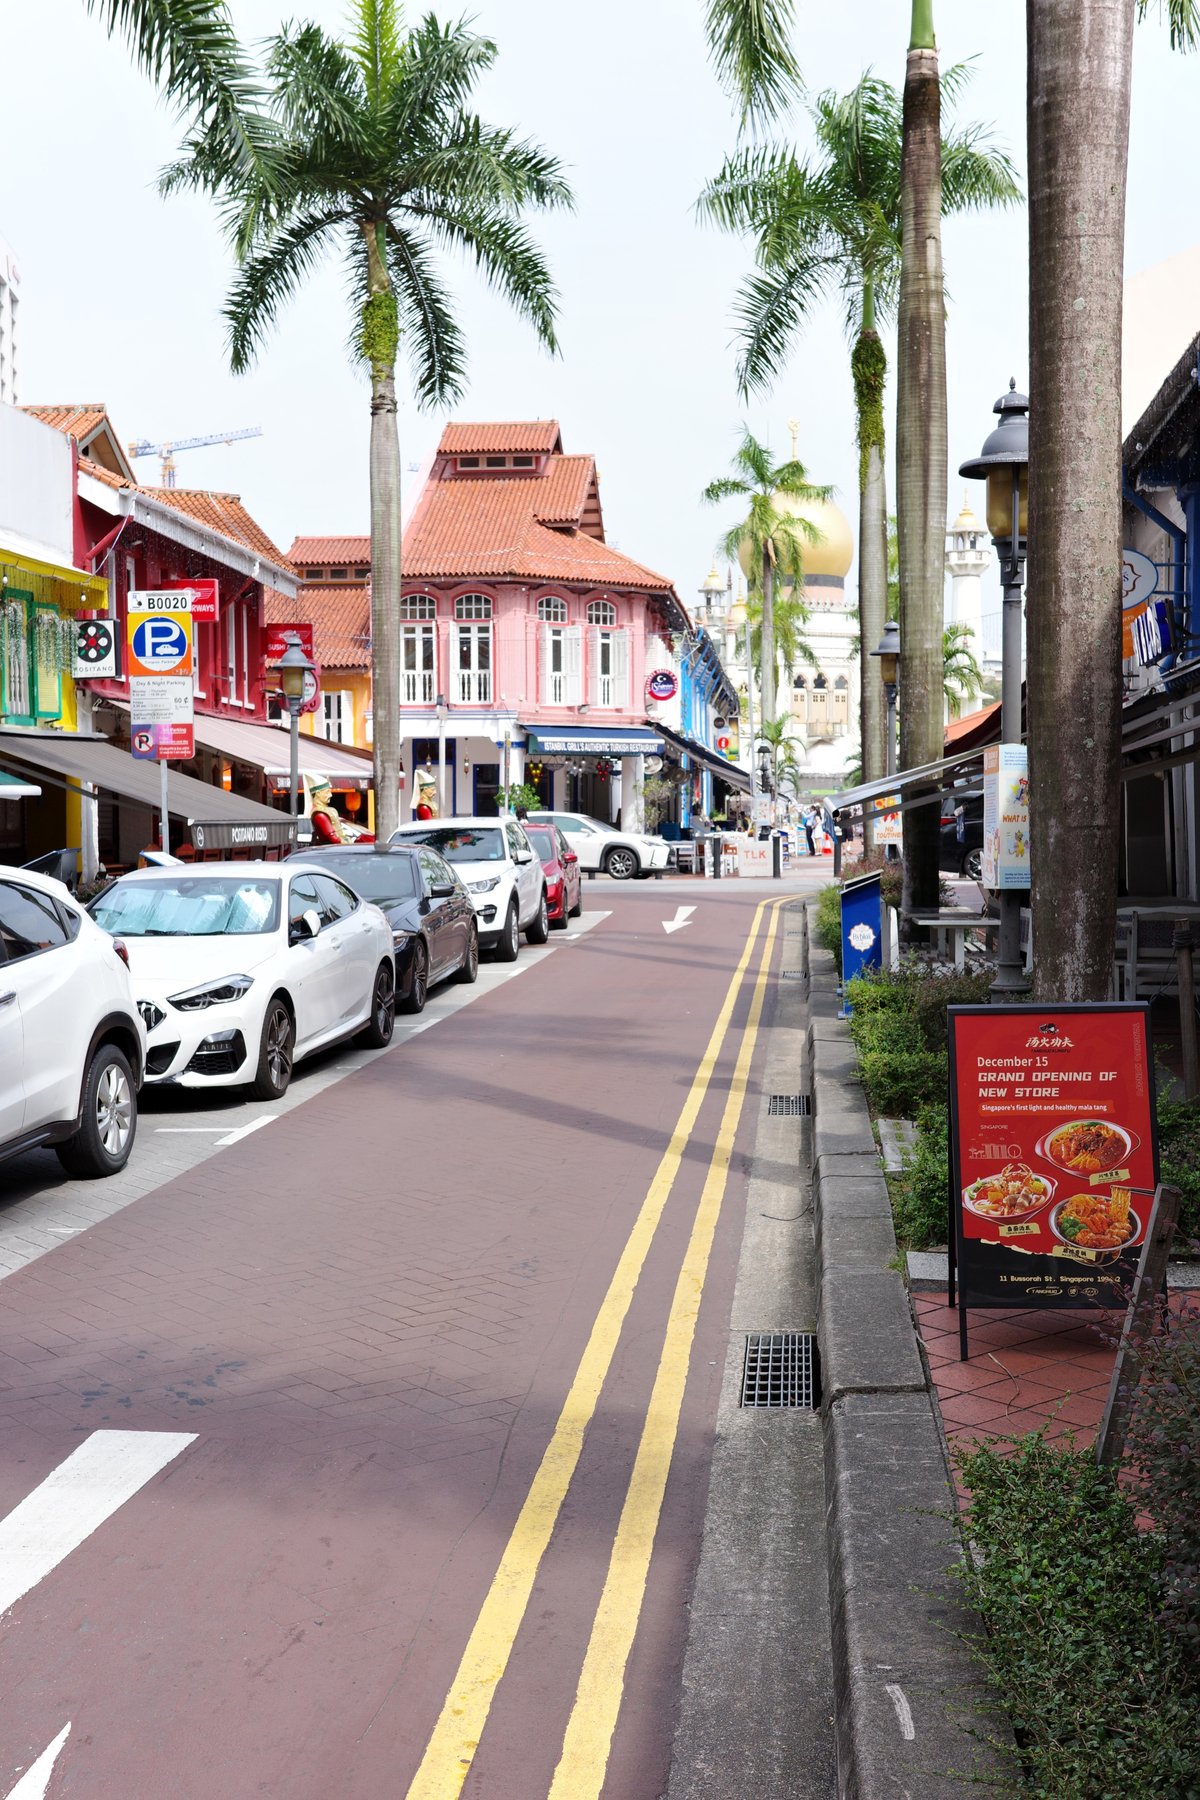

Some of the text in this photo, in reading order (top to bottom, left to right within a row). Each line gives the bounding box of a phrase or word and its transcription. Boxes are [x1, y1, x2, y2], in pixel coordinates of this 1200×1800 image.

[148, 597, 187, 610] B0020
[268, 643, 286, 651] SUSHI
[544, 741, 567, 751] ISTANBUL
[585, 742, 610, 752] AUTHENTIC
[610, 742, 630, 752] TURKISH
[630, 743, 658, 753] RESTAURANT
[1002, 815, 1019, 823] WHAT
[231, 827, 255, 842] POSITANO
[255, 827, 268, 841] RISTO
[743, 850, 766, 859] TLK
[1025, 1036, 1075, 1048] 汤火功夫
[977, 1056, 1048, 1067] December 15
[978, 1071, 1118, 1082] GRAND OPENING OF
[978, 1087, 1060, 1097] NEW STORE
[981, 1104, 1016, 1112] Singapore's
[1028, 1104, 1042, 1112] light
[1055, 1104, 1077, 1112] healthy
[1093, 1104, 1107, 1112] tang
[1059, 1275, 1094, 1284] Singapore
